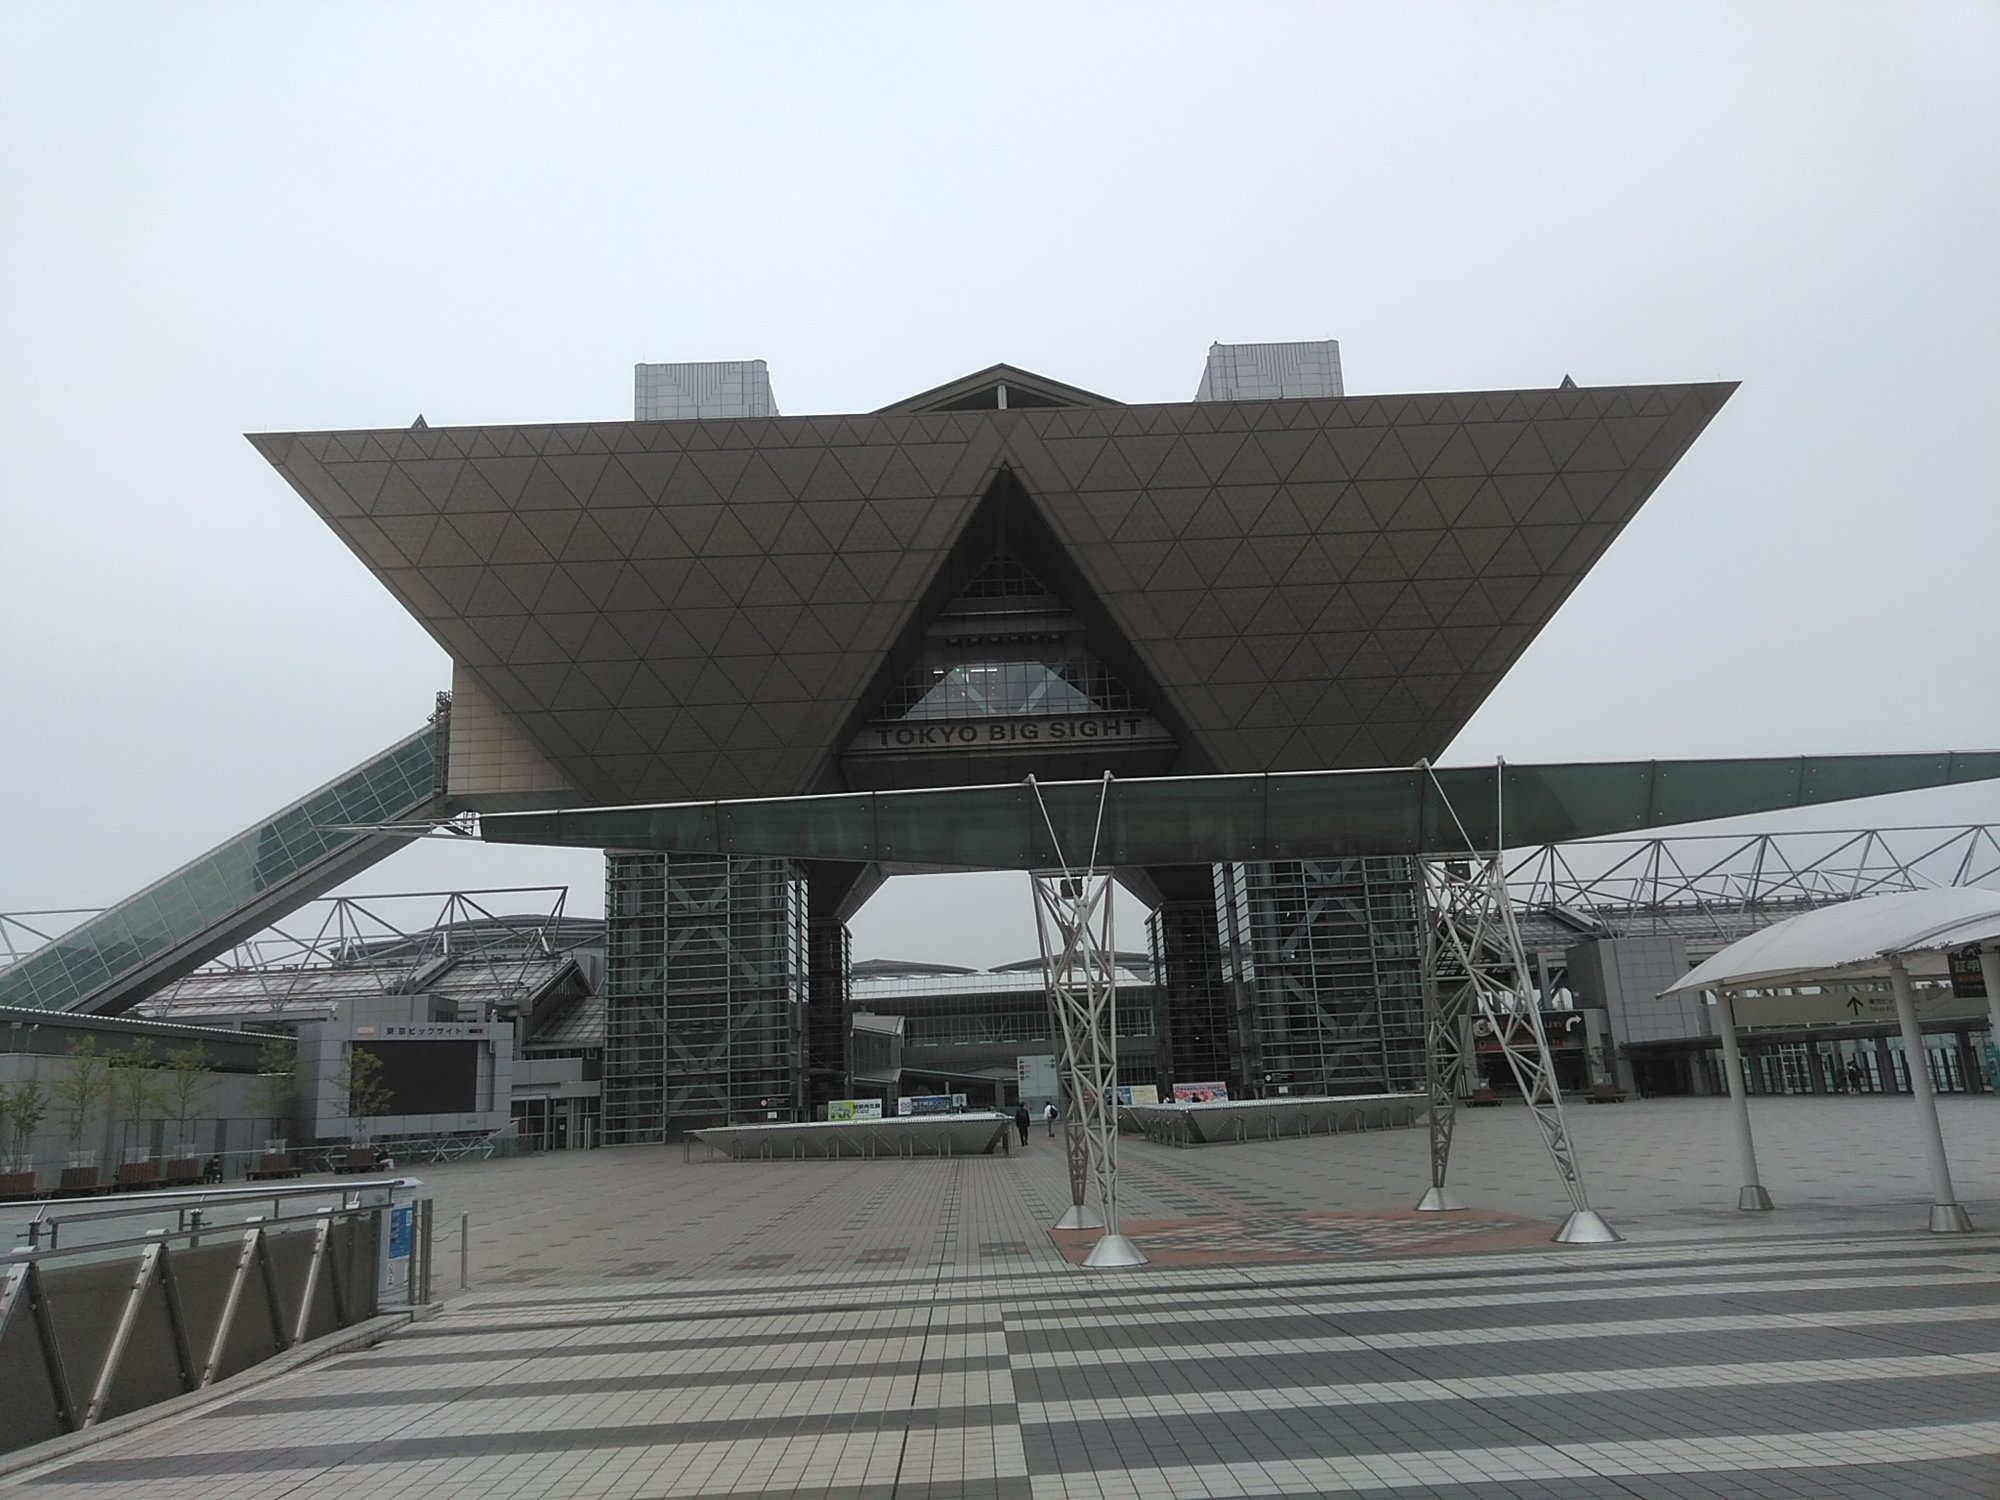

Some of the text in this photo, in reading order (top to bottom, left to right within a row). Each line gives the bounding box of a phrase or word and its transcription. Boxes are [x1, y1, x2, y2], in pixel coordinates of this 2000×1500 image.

[875, 718, 1142, 746] TOKYO BIG SIGHT
[385, 1026, 463, 1036] 東京ビッグサイト
